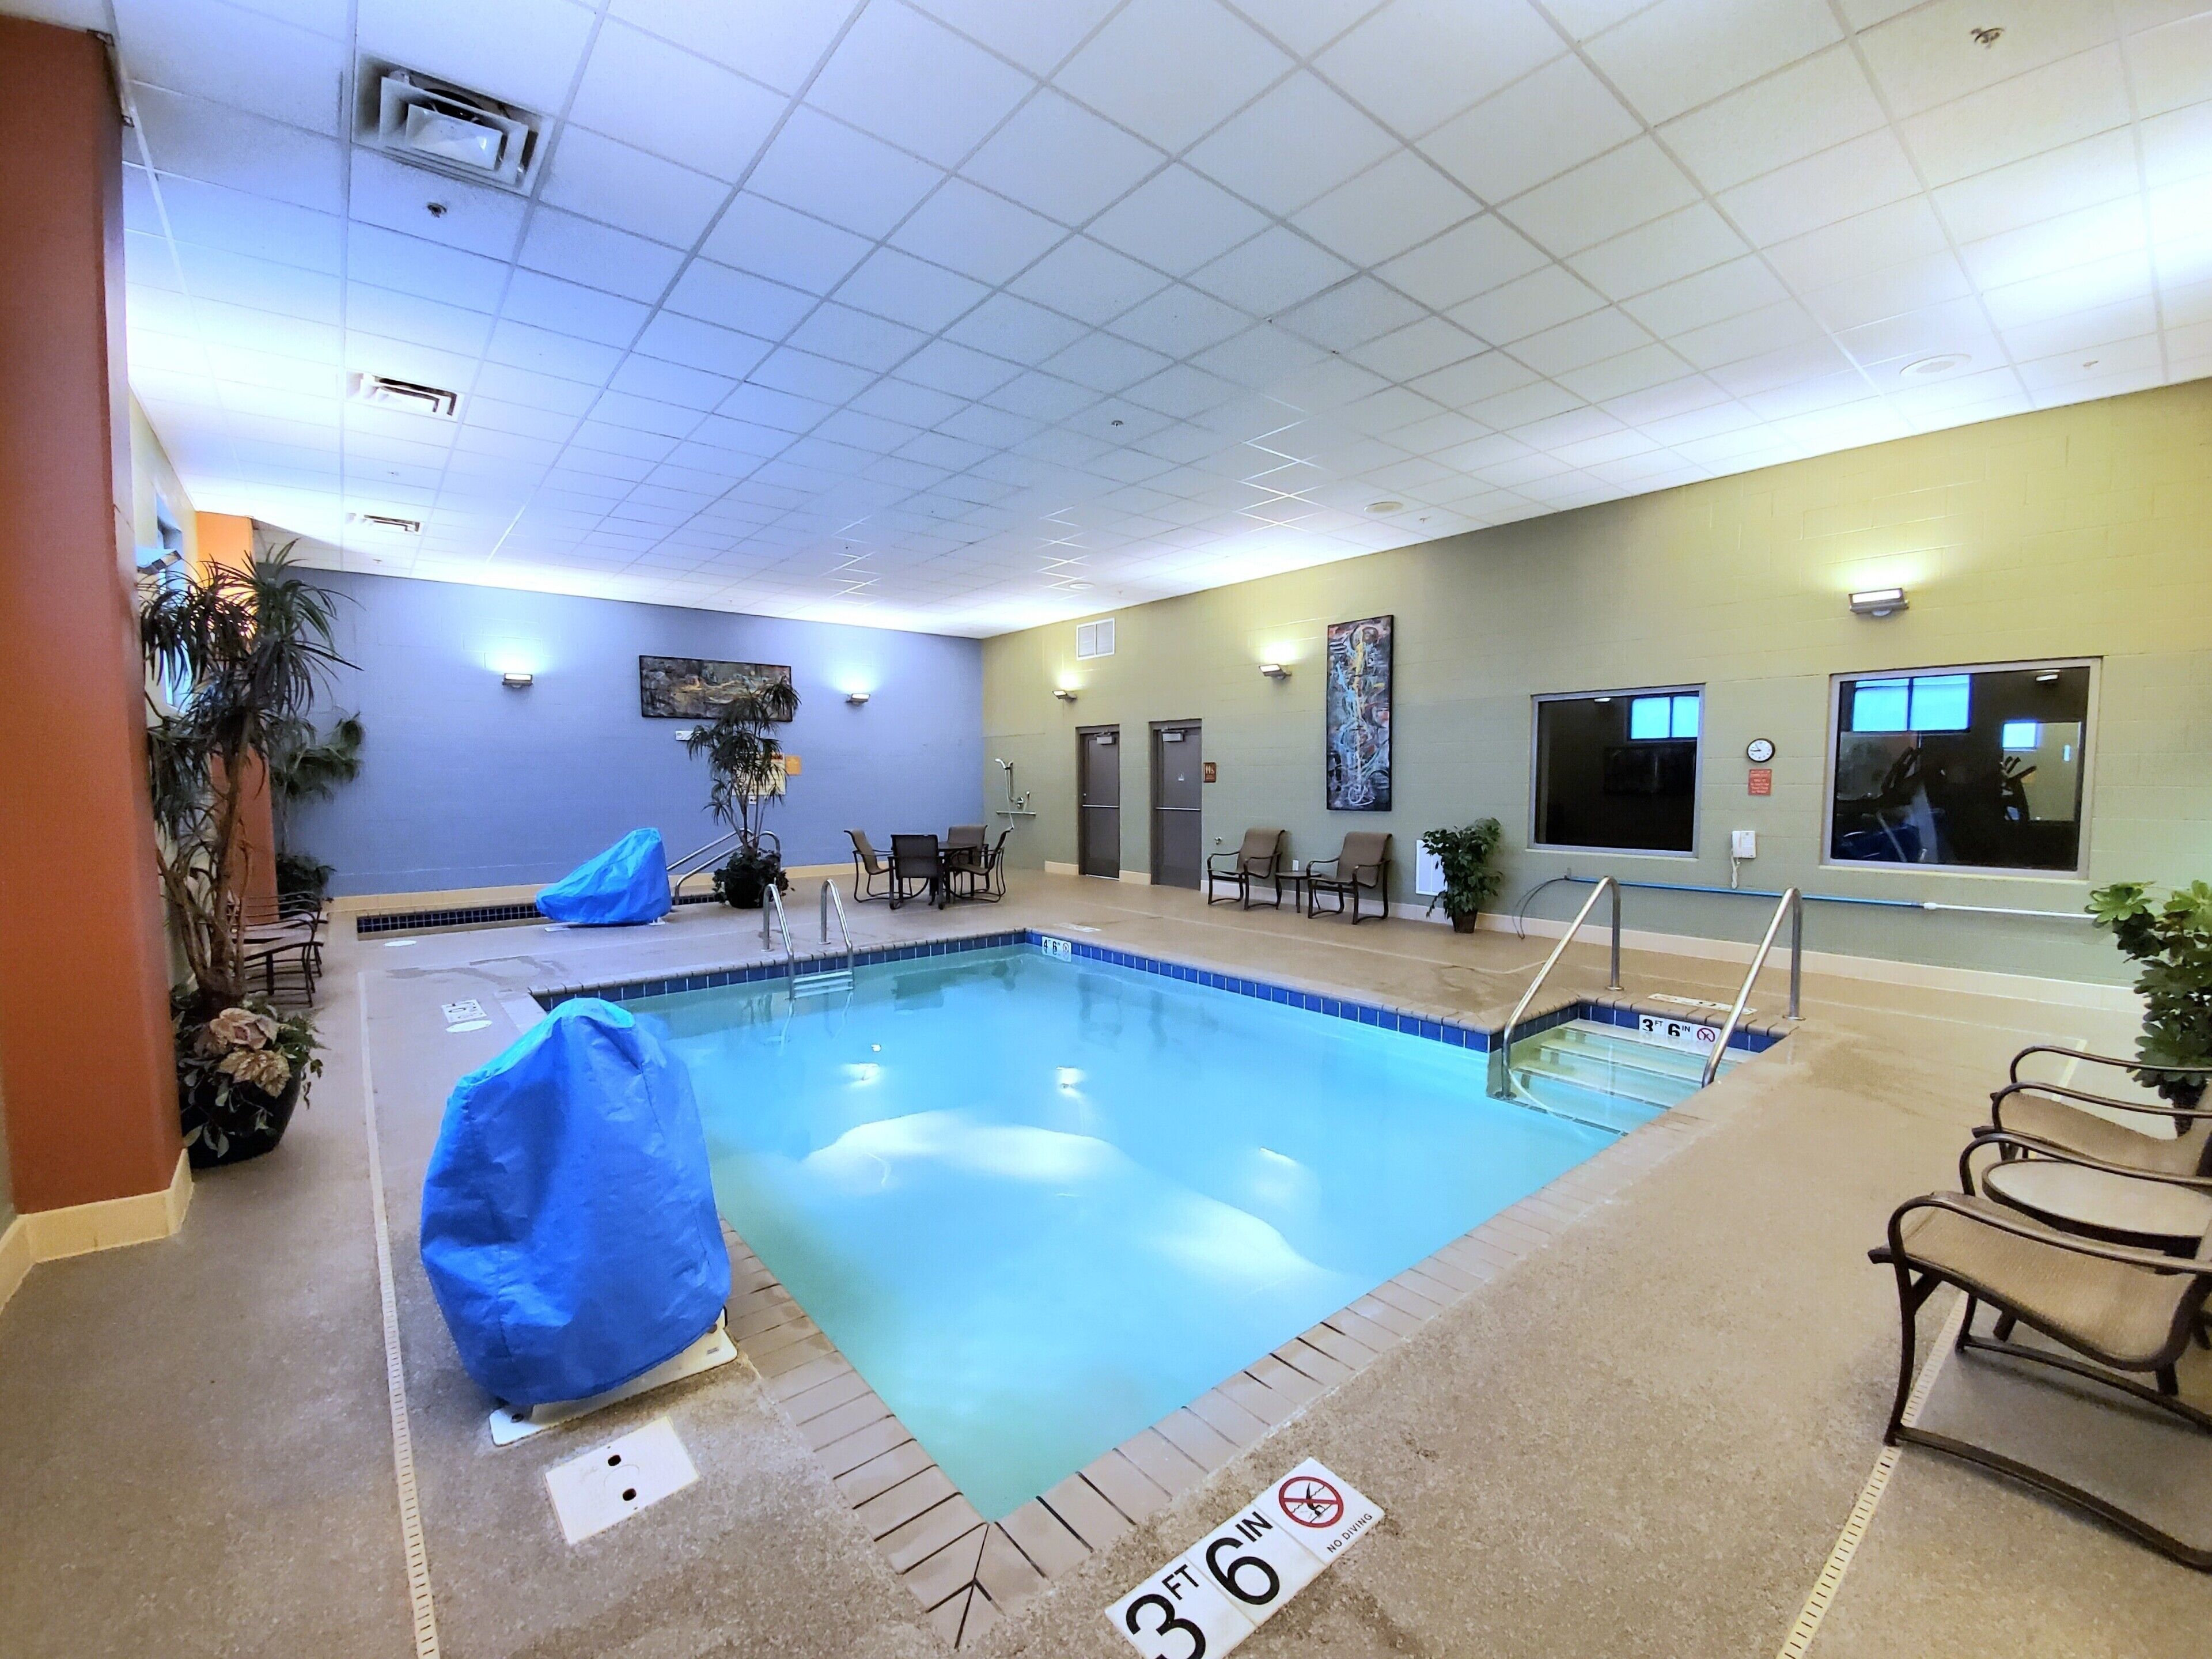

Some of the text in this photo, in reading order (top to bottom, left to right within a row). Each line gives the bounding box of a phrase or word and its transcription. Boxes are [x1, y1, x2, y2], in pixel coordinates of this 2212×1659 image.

[1642, 1018, 1653, 1032] 3
[1668, 1023, 1680, 1037] 6
[1327, 1513, 1373, 1553] NO DIVING
[1126, 1511, 1280, 1659] 3 FT 6 IN
